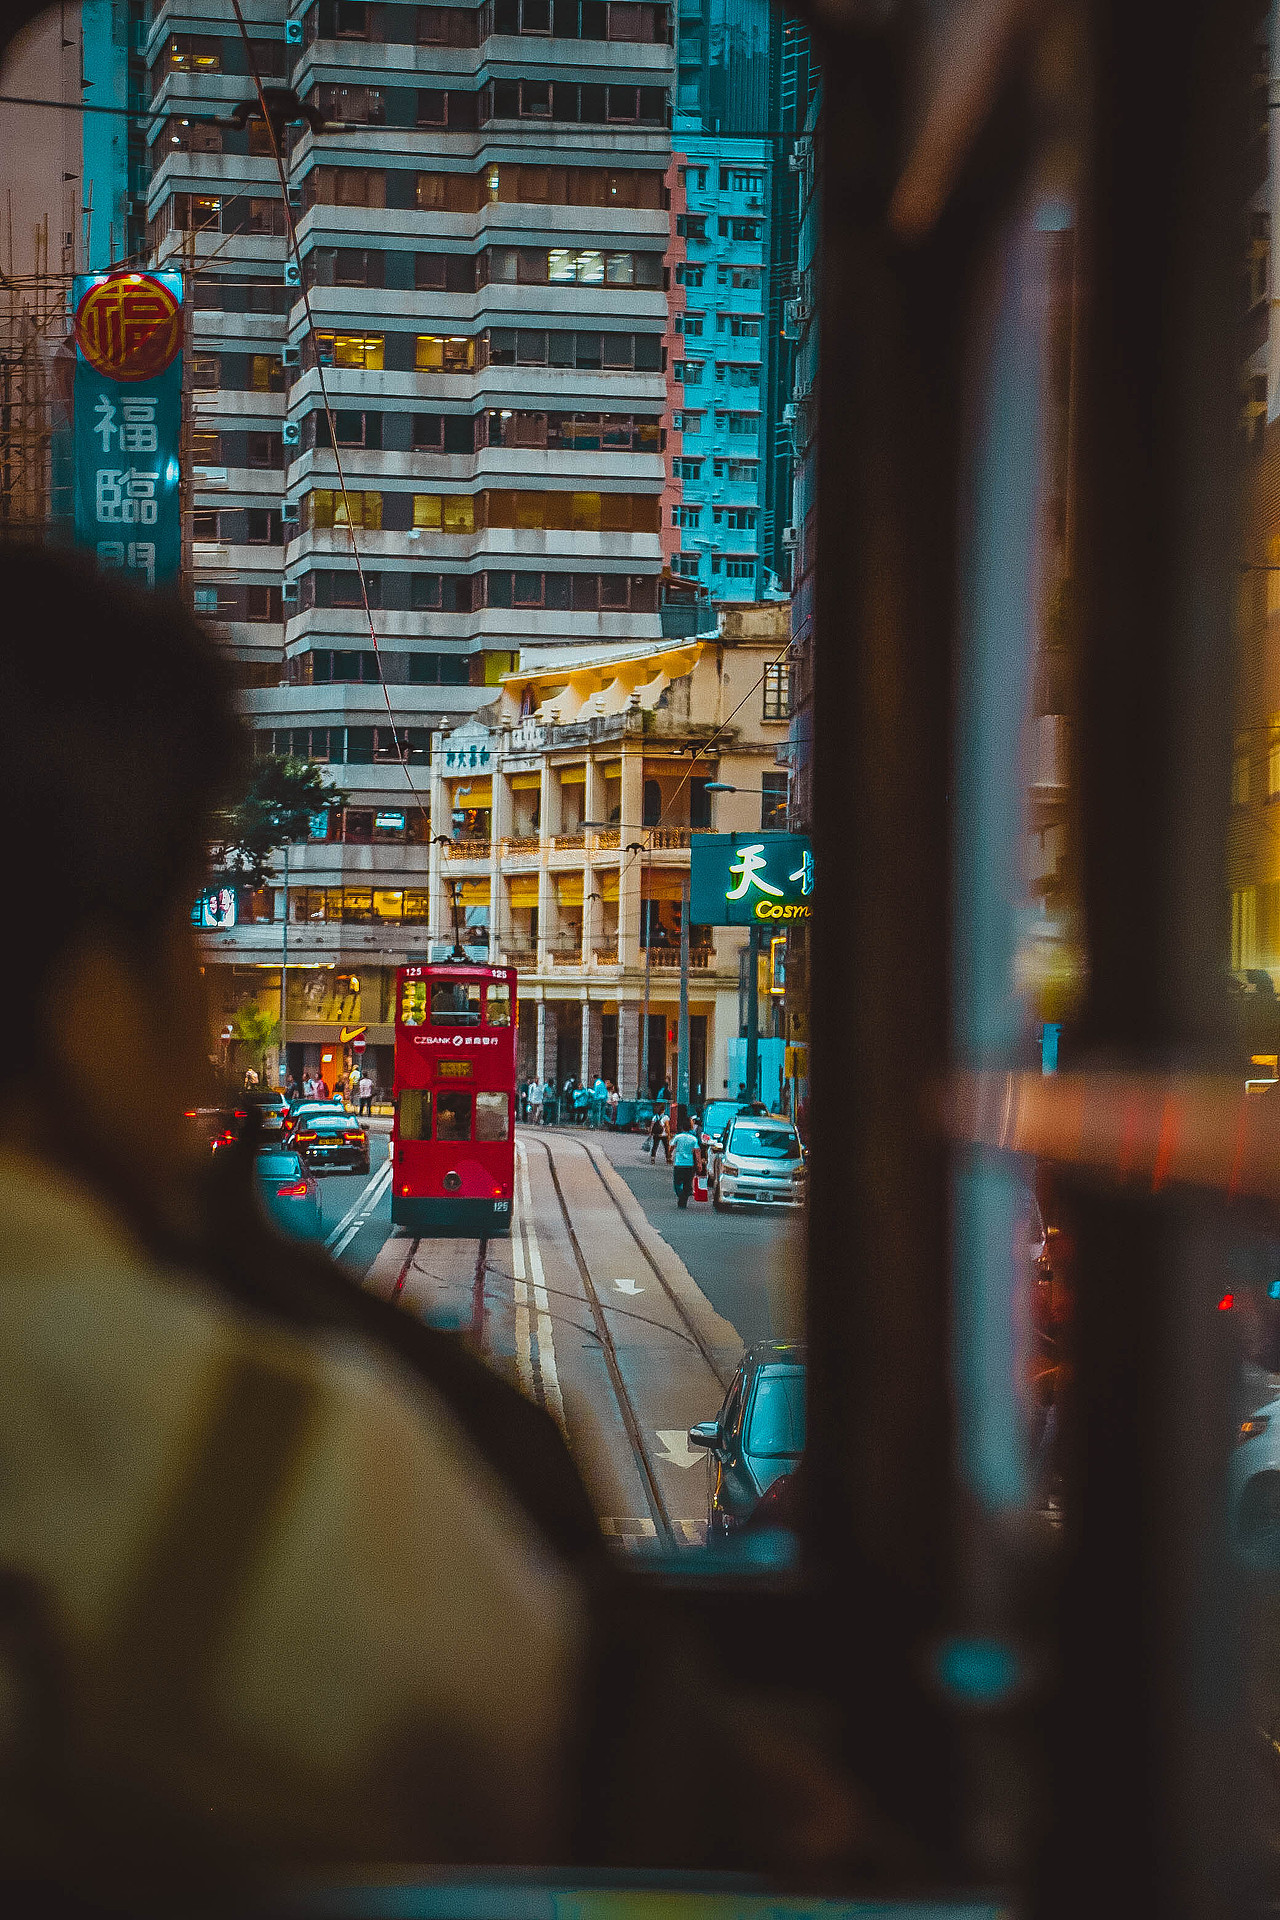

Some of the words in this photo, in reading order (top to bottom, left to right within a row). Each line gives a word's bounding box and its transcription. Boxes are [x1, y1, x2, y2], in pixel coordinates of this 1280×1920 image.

[94, 394, 160, 590] 福臨門
[406, 967, 422, 976] 125
[413, 1036, 451, 1045] CZBANK
